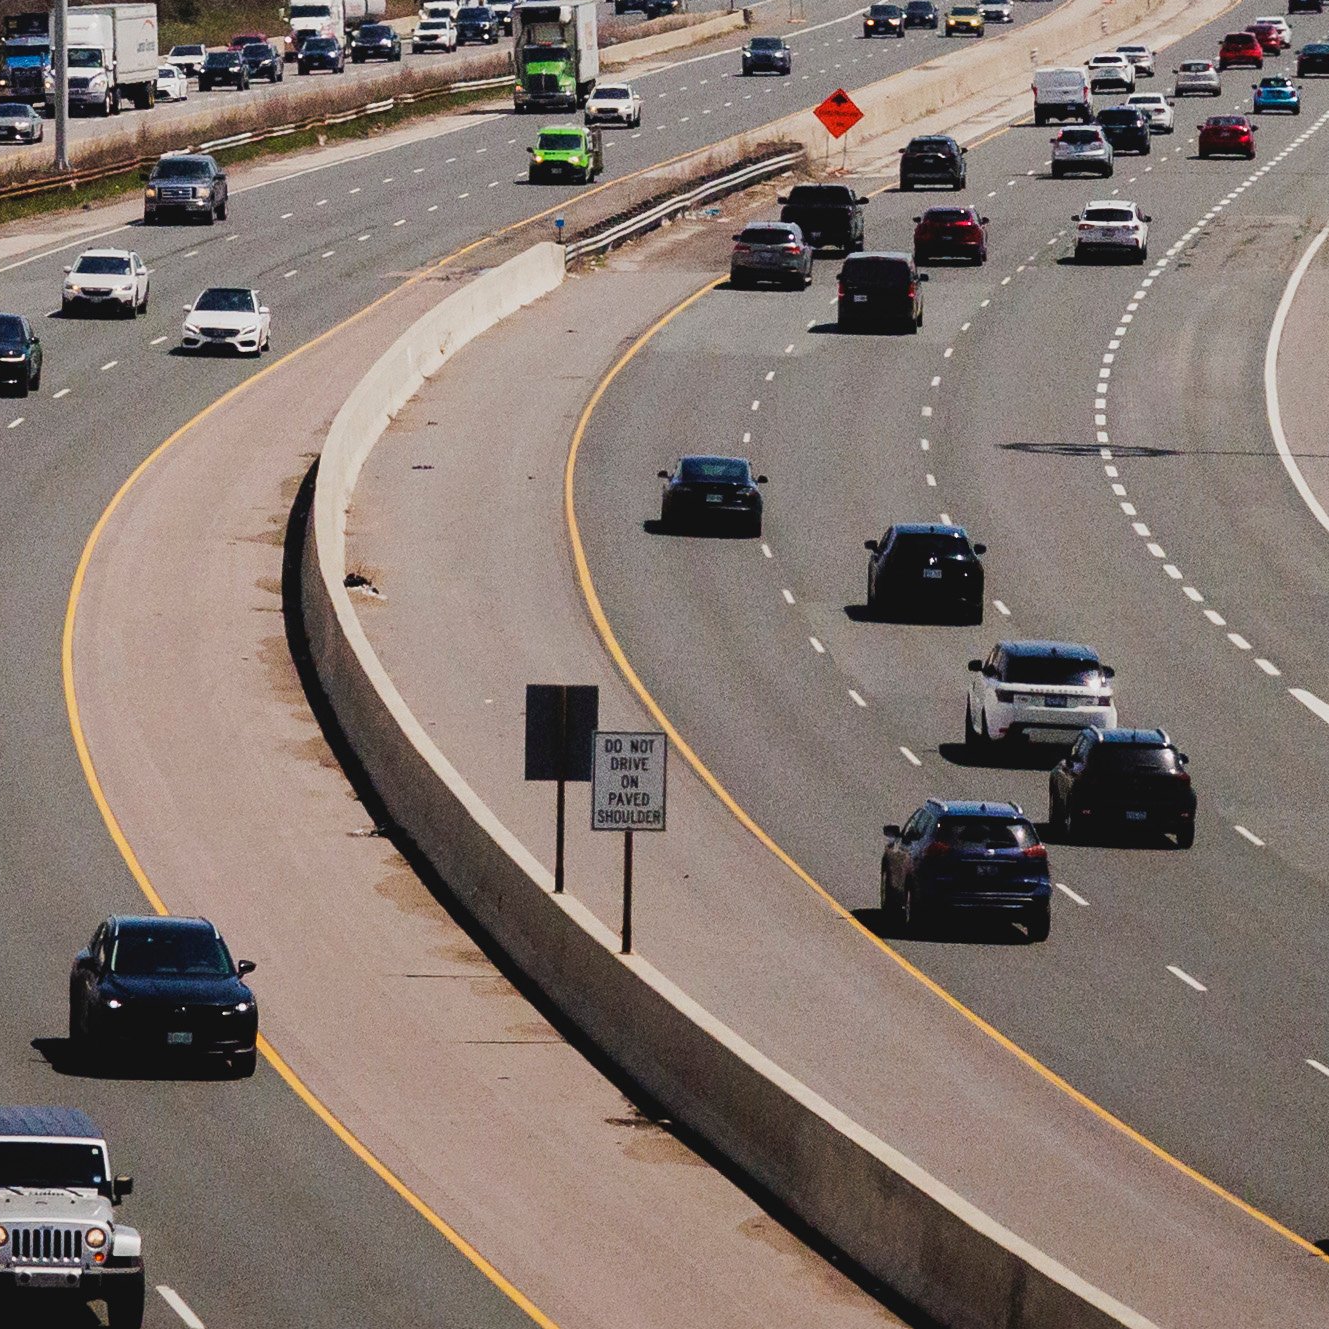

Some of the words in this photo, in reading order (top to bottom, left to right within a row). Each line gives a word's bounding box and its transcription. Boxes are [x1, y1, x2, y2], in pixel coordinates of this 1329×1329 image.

[604, 739, 622, 753] DO
[630, 739, 655, 754] NOT
[610, 757, 650, 771] DRIVE
[621, 775, 639, 789] ON
[608, 792, 650, 806] PAVED
[597, 809, 662, 824] SHOULDER
